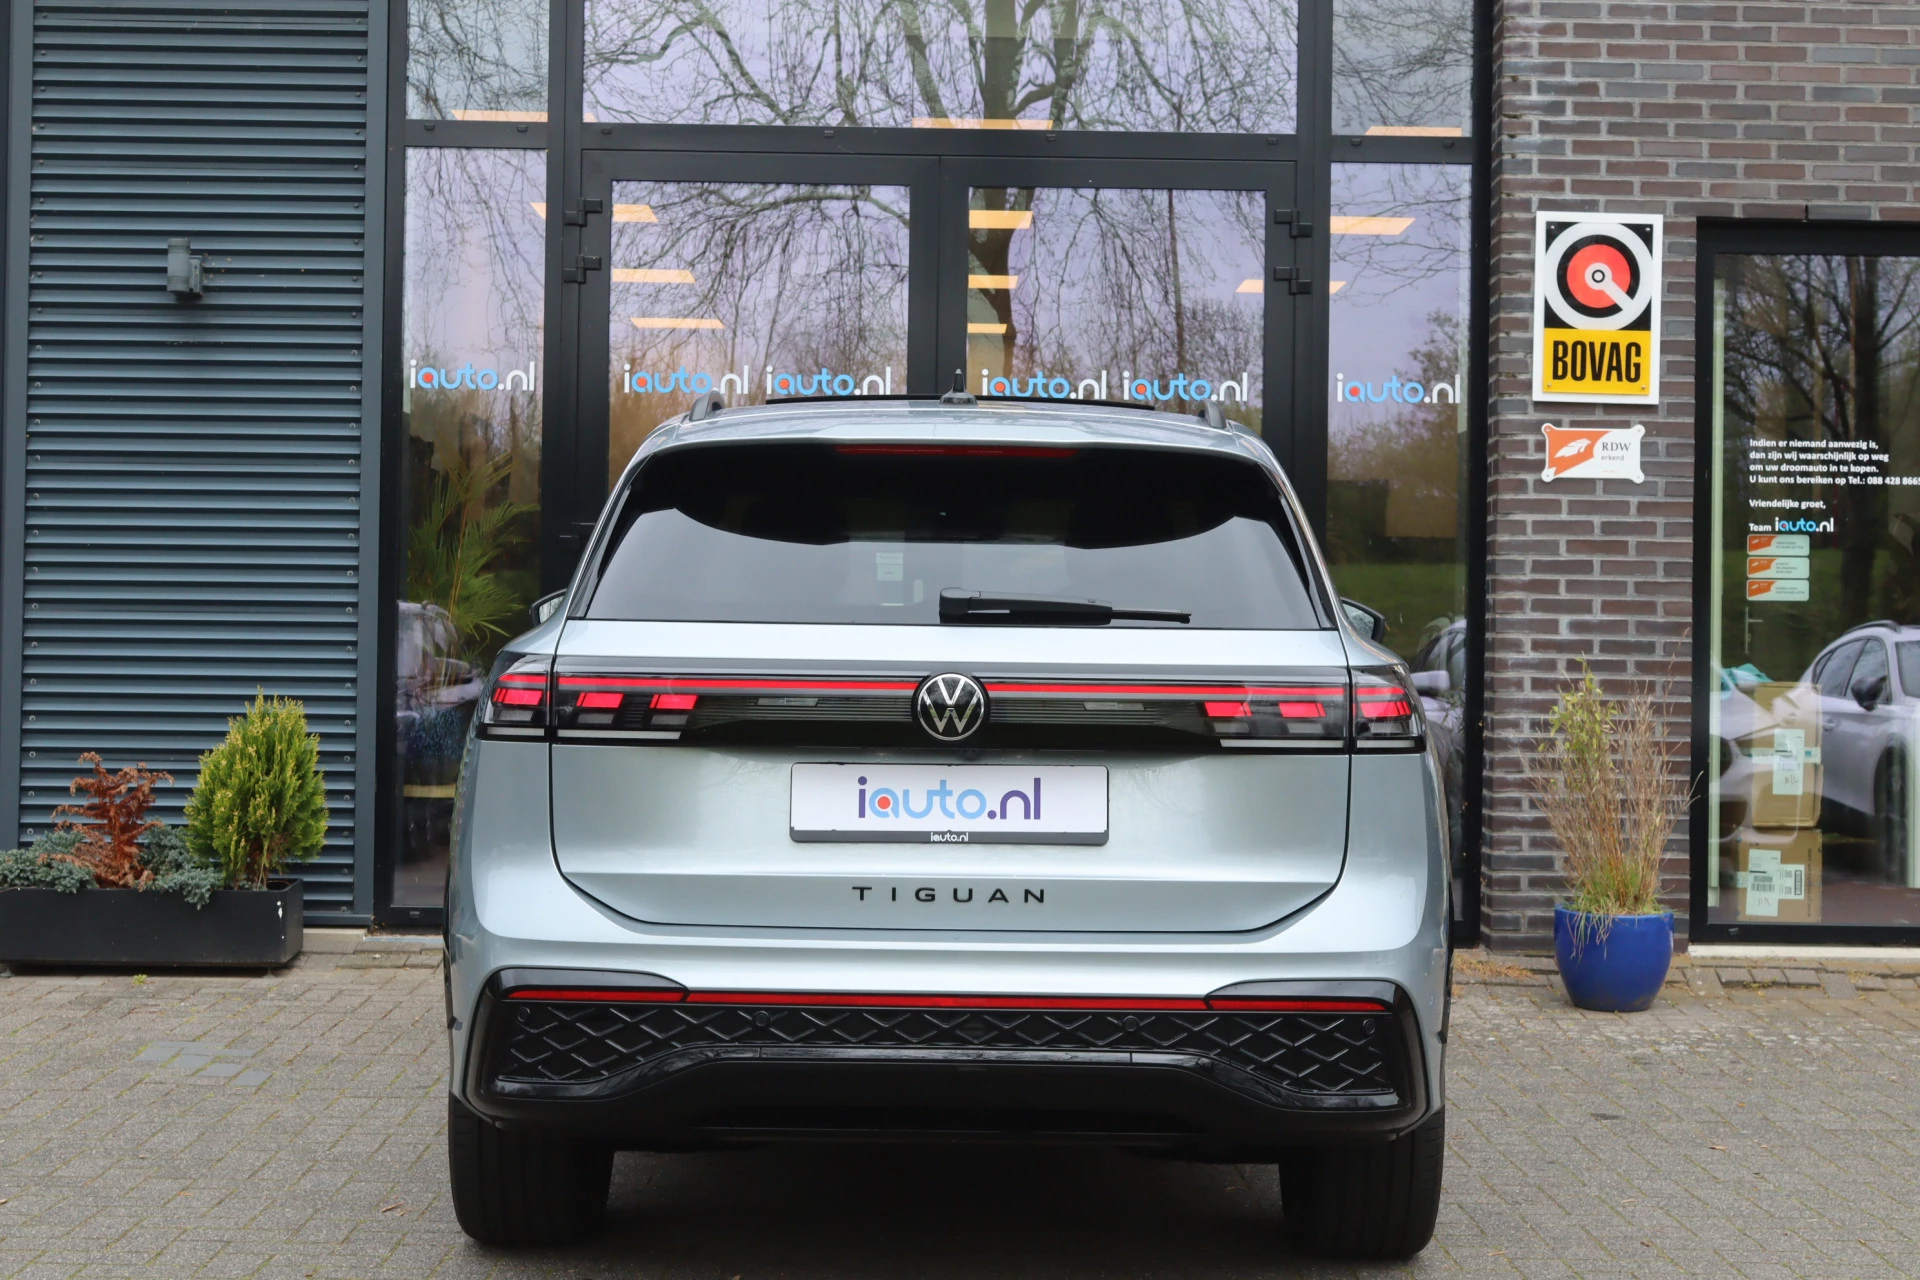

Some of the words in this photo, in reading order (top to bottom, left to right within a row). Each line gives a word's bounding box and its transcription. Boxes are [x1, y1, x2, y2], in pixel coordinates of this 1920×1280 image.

[1552, 340, 1642, 383] BOVAG
[409, 359, 536, 392] iauto.nl
[766, 365, 892, 396] iauto.nl
[981, 368, 1107, 400] iauto.nl
[1122, 370, 1249, 402] iauto.nl
[1336, 372, 1461, 405] iauto.nl
[1601, 441, 1631, 452] RDW
[1749, 439, 1777, 447] Indien
[1789, 439, 1827, 448] niemand
[1828, 440, 1868, 450] aanwezig
[1869, 440, 1879, 450] is,
[1749, 450, 1766, 459] dan
[1767, 450, 1783, 461] zijn
[1784, 451, 1798, 461] wij
[1799, 451, 1856, 462] waarschijnlijk
[1858, 453, 1870, 462] op
[1871, 453, 1890, 462] weg
[1780, 463, 1828, 472] droomauto
[1829, 464, 1838, 472] in
[1850, 464, 1879, 474] kopen.
[1749, 475, 1757, 483] U
[1758, 475, 1778, 483] kunt
[1796, 475, 1833, 484] bereiken
[1834, 477, 1847, 486] op
[1867, 476, 1883, 485] 088
[1884, 476, 1901, 486] 428
[1749, 499, 1799, 509] Vriendelijke
[1800, 500, 1827, 510] groet,
[1749, 523, 1772, 532] Team
[1775, 516, 1834, 532] iauto.nl
[857, 775, 1041, 820] iauto.nl
[930, 832, 969, 842] iauto.nl
[852, 886, 1044, 903] TIGUAN
